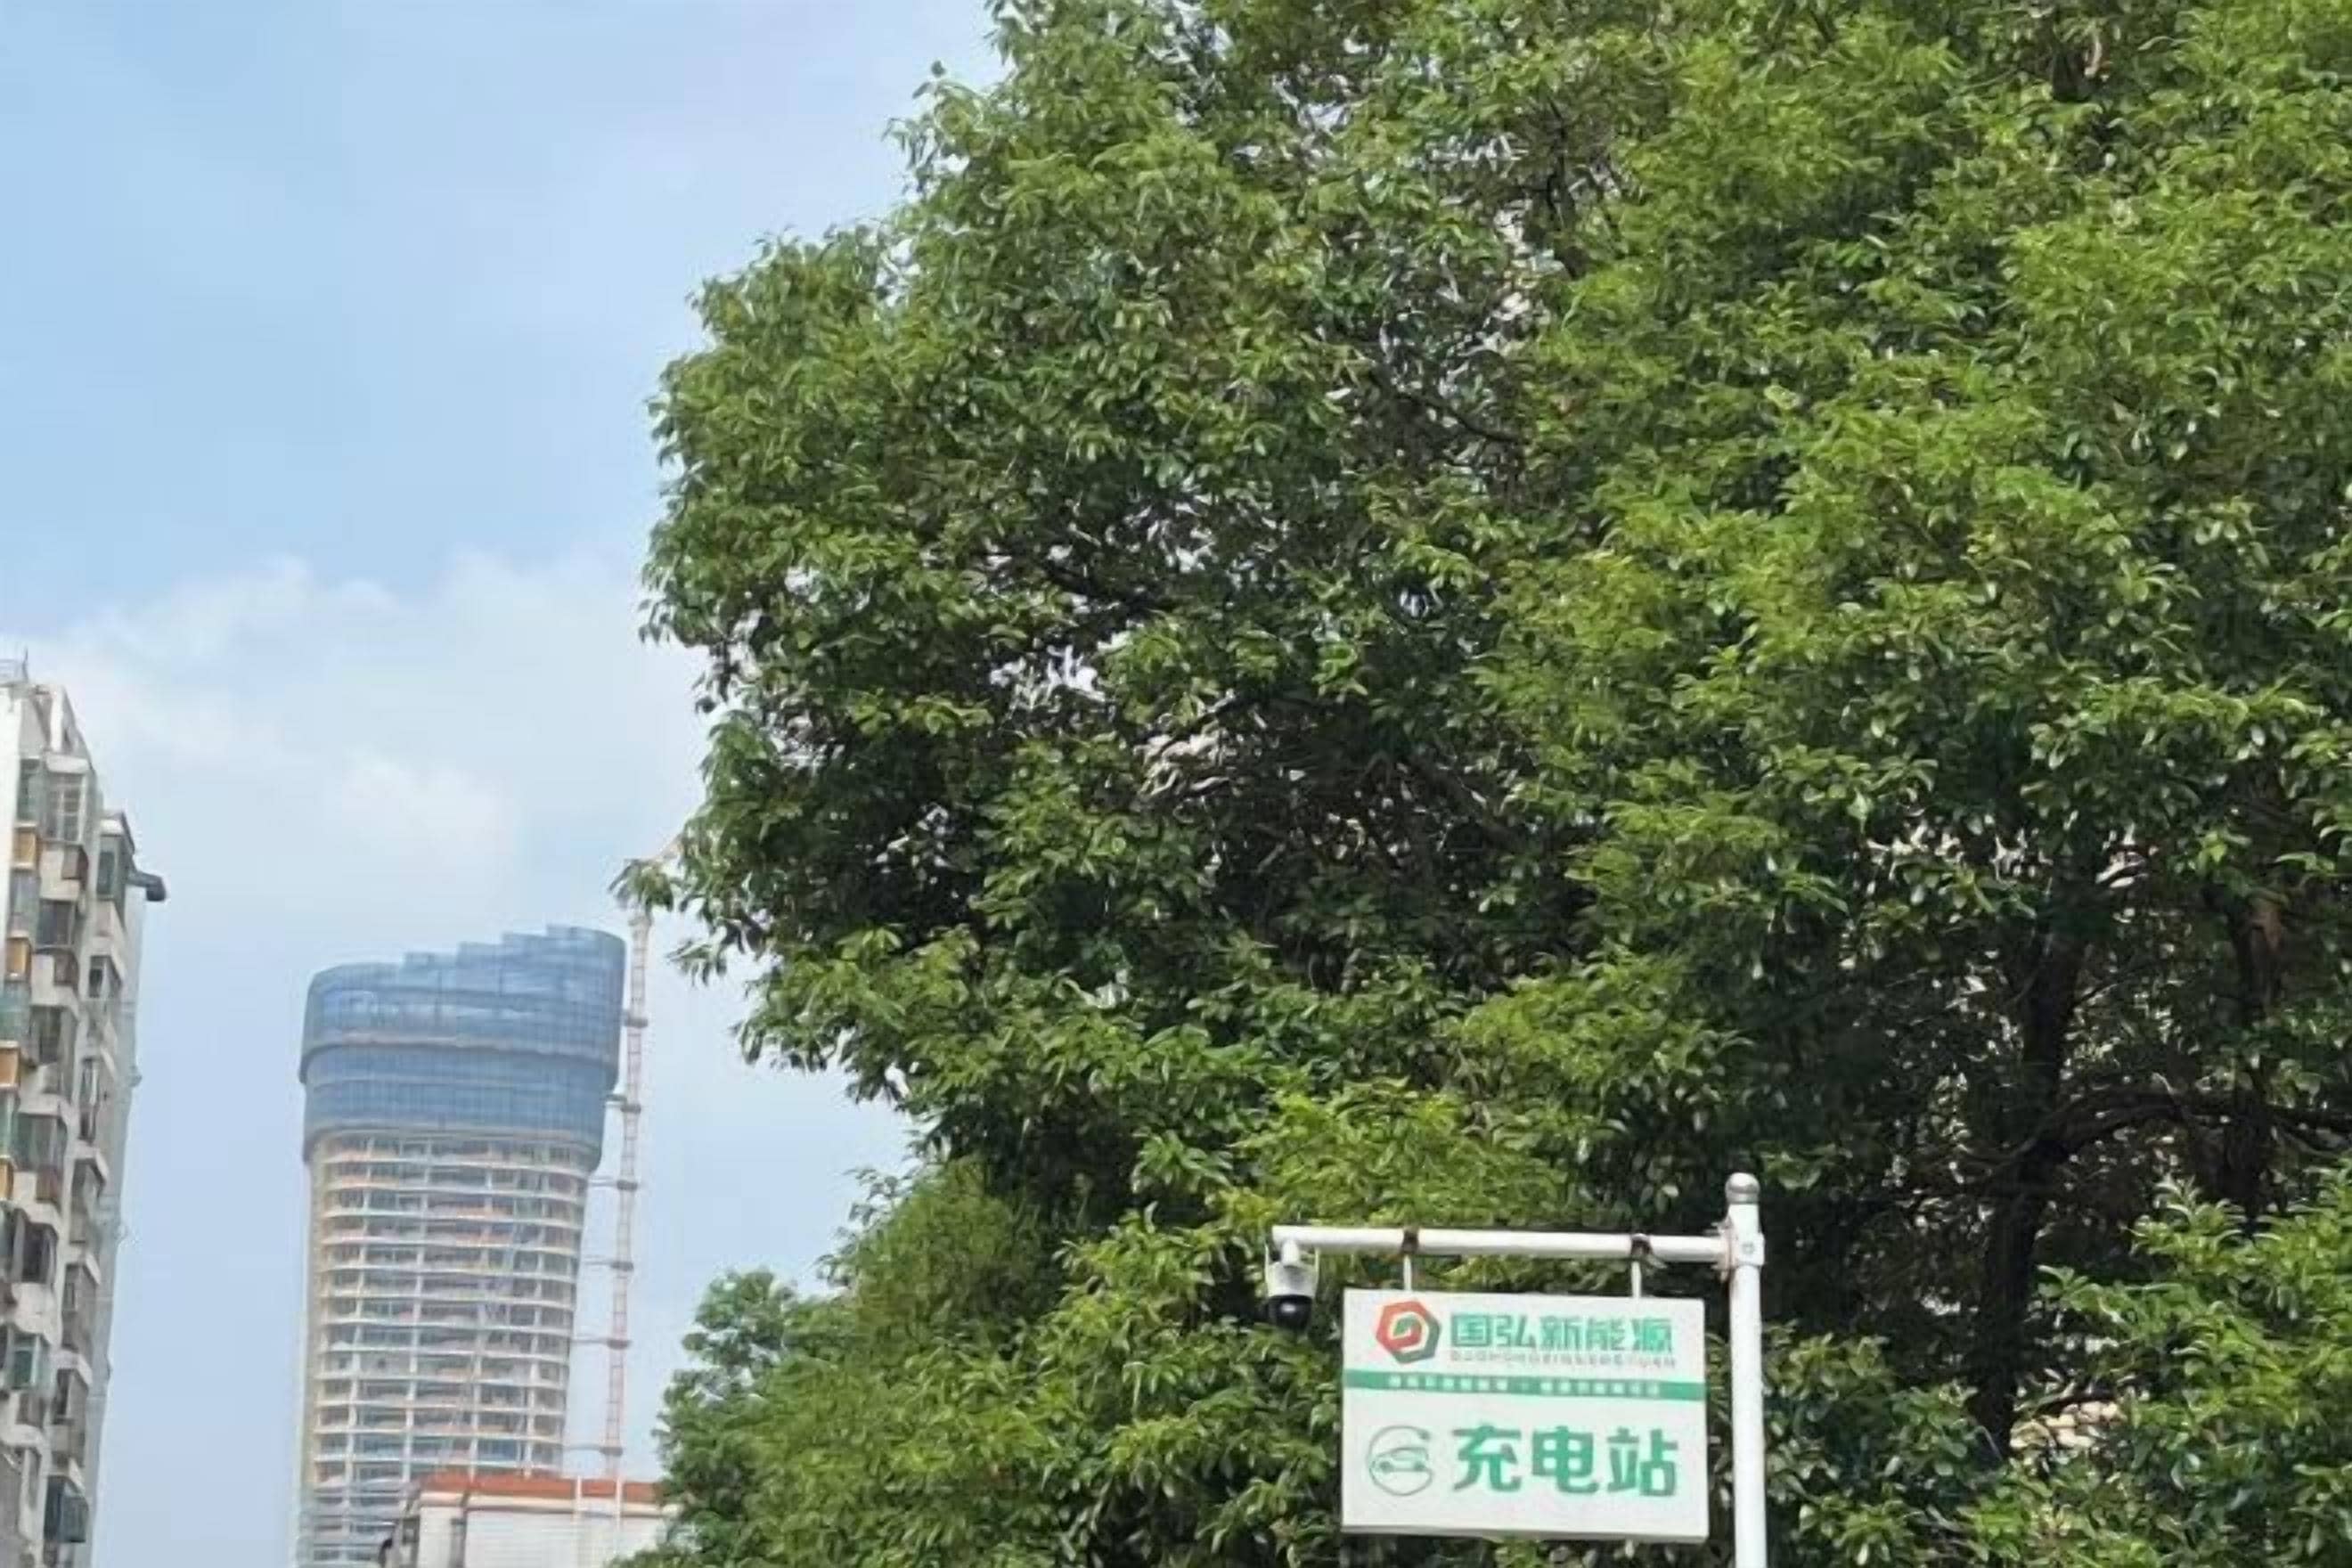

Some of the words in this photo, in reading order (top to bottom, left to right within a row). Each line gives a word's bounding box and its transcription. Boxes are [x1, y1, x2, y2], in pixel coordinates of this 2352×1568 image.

[1450, 1314, 1672, 1352] 国弘新能源
[1452, 1423, 1678, 1498] 充电站
